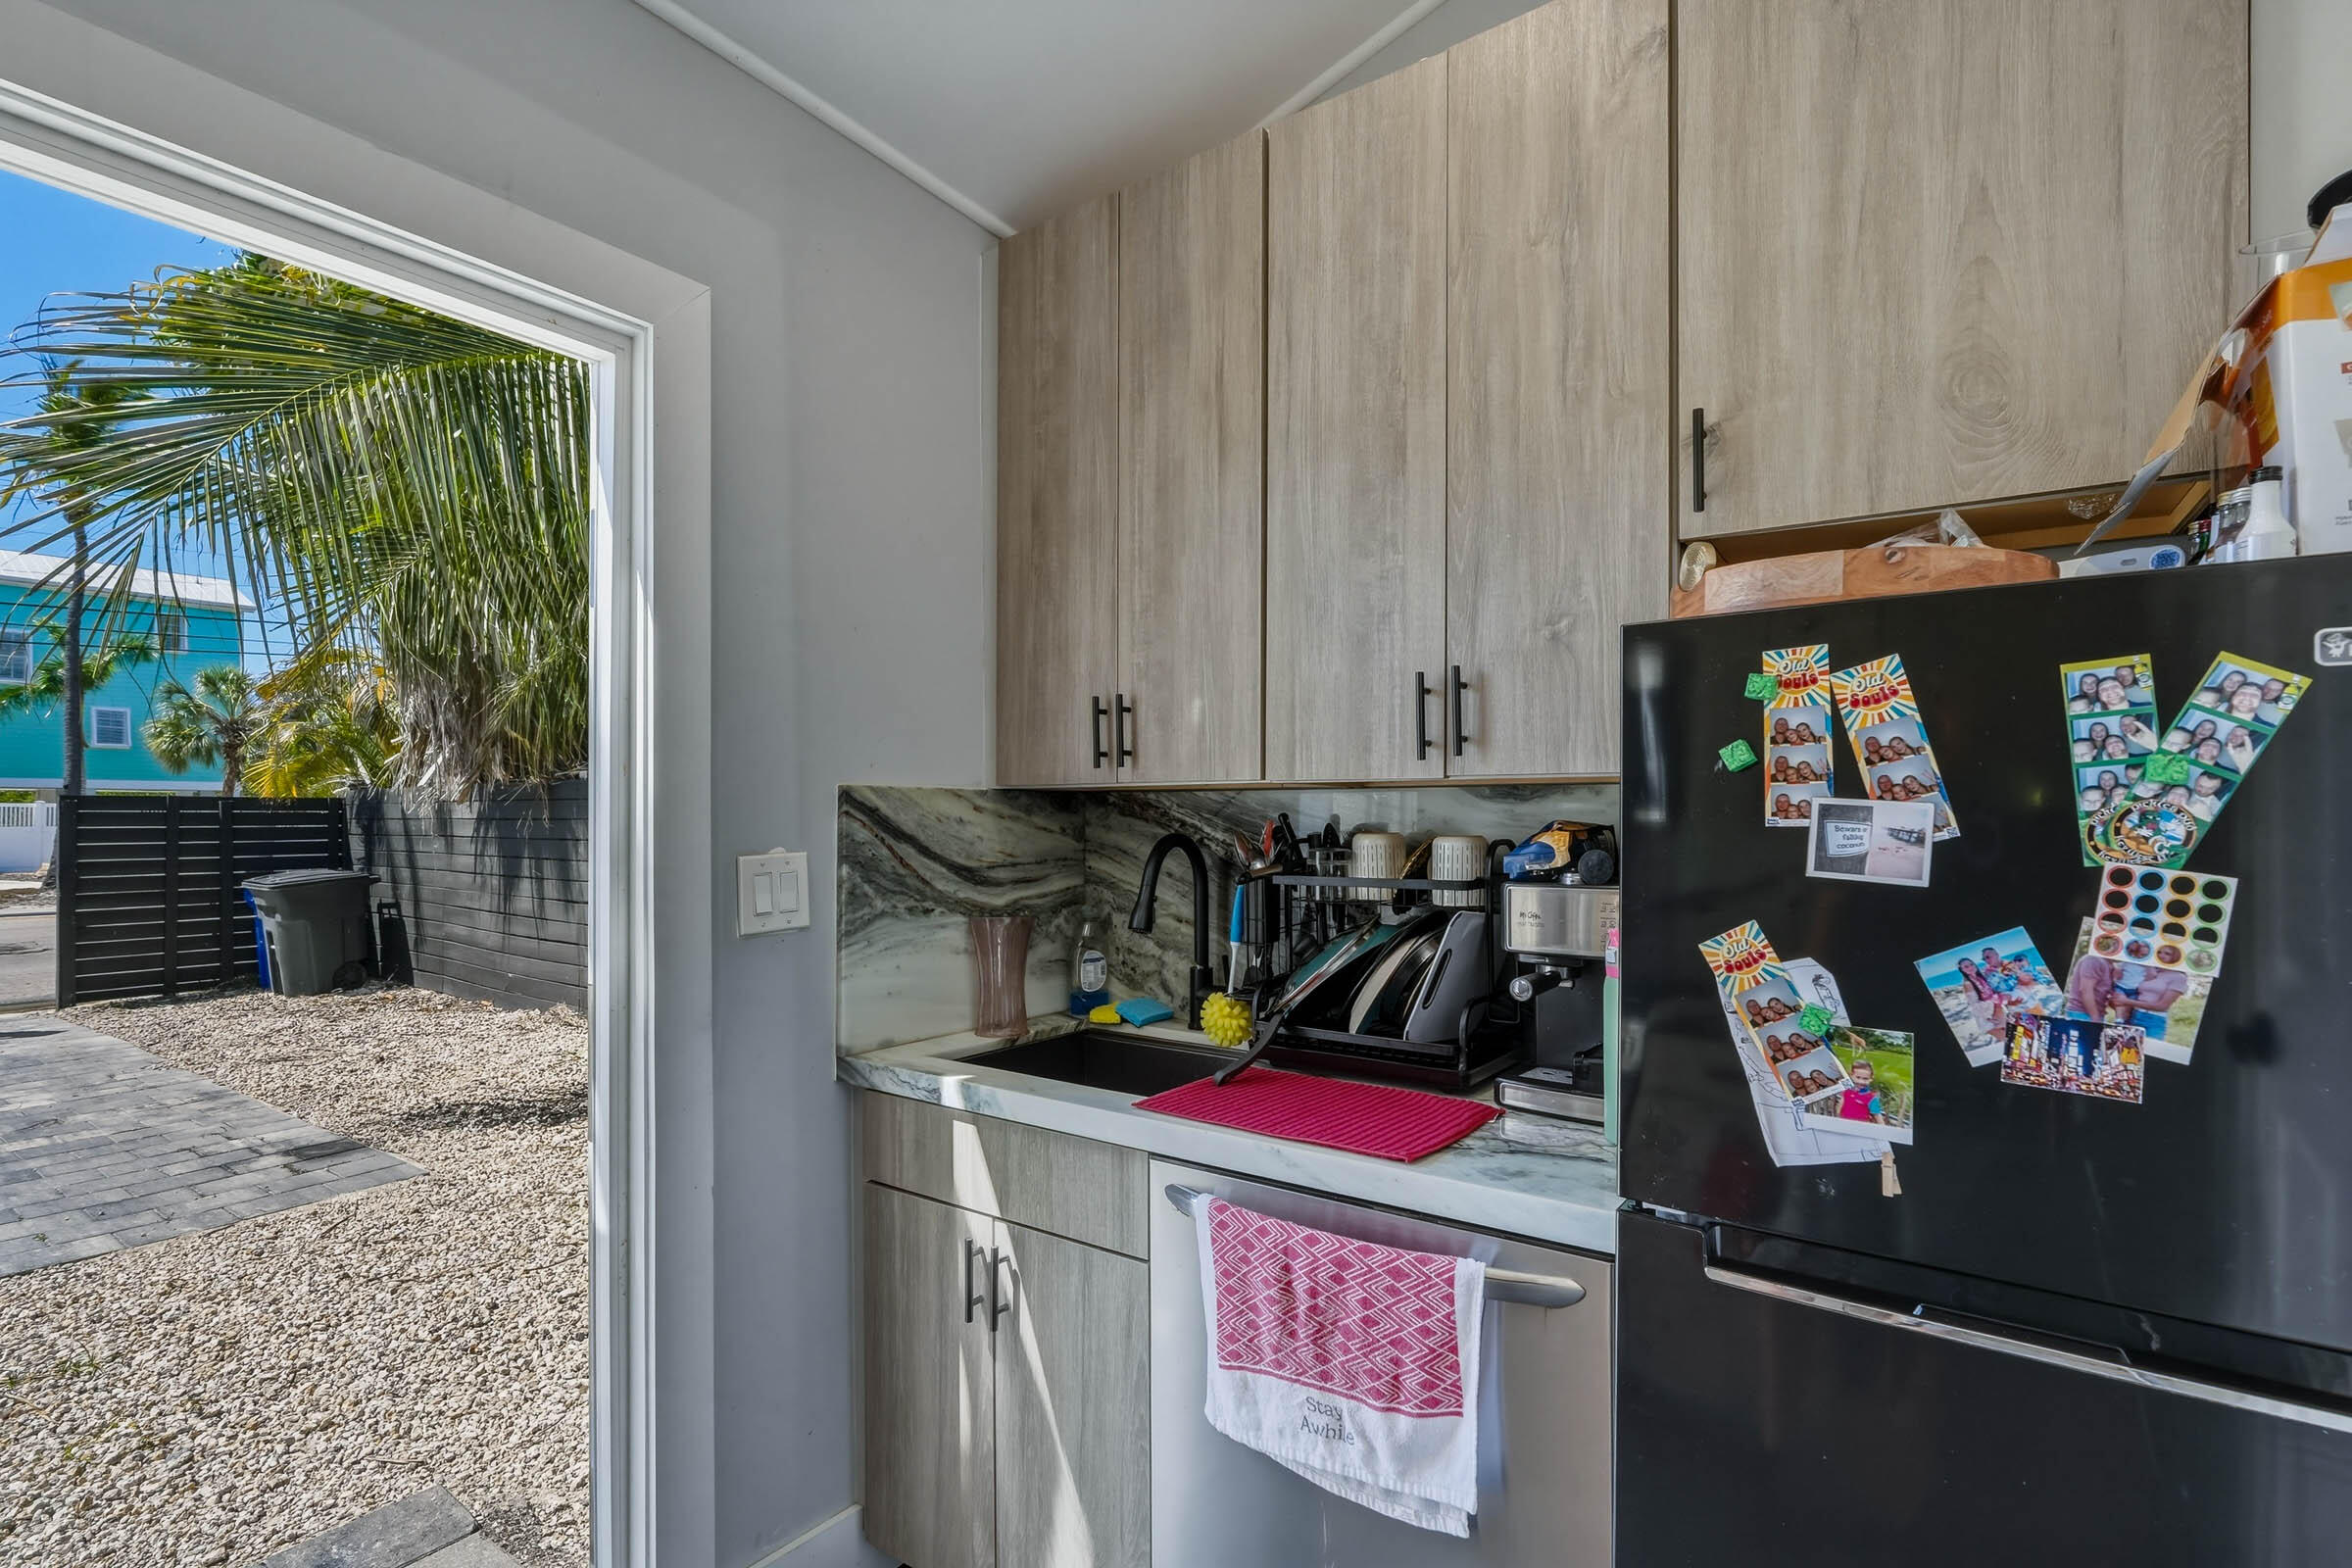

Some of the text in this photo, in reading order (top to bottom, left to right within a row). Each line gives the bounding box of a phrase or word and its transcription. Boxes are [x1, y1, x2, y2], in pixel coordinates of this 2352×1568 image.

[1779, 659, 1809, 674] Old
[1850, 673, 1886, 692] Old
[1849, 685, 1900, 709] Souls
[1723, 938, 1753, 958] Old
[1723, 949, 1767, 974] Souls
[1305, 1396, 1343, 1421] Stay
[1300, 1415, 1355, 1446] Awhile
